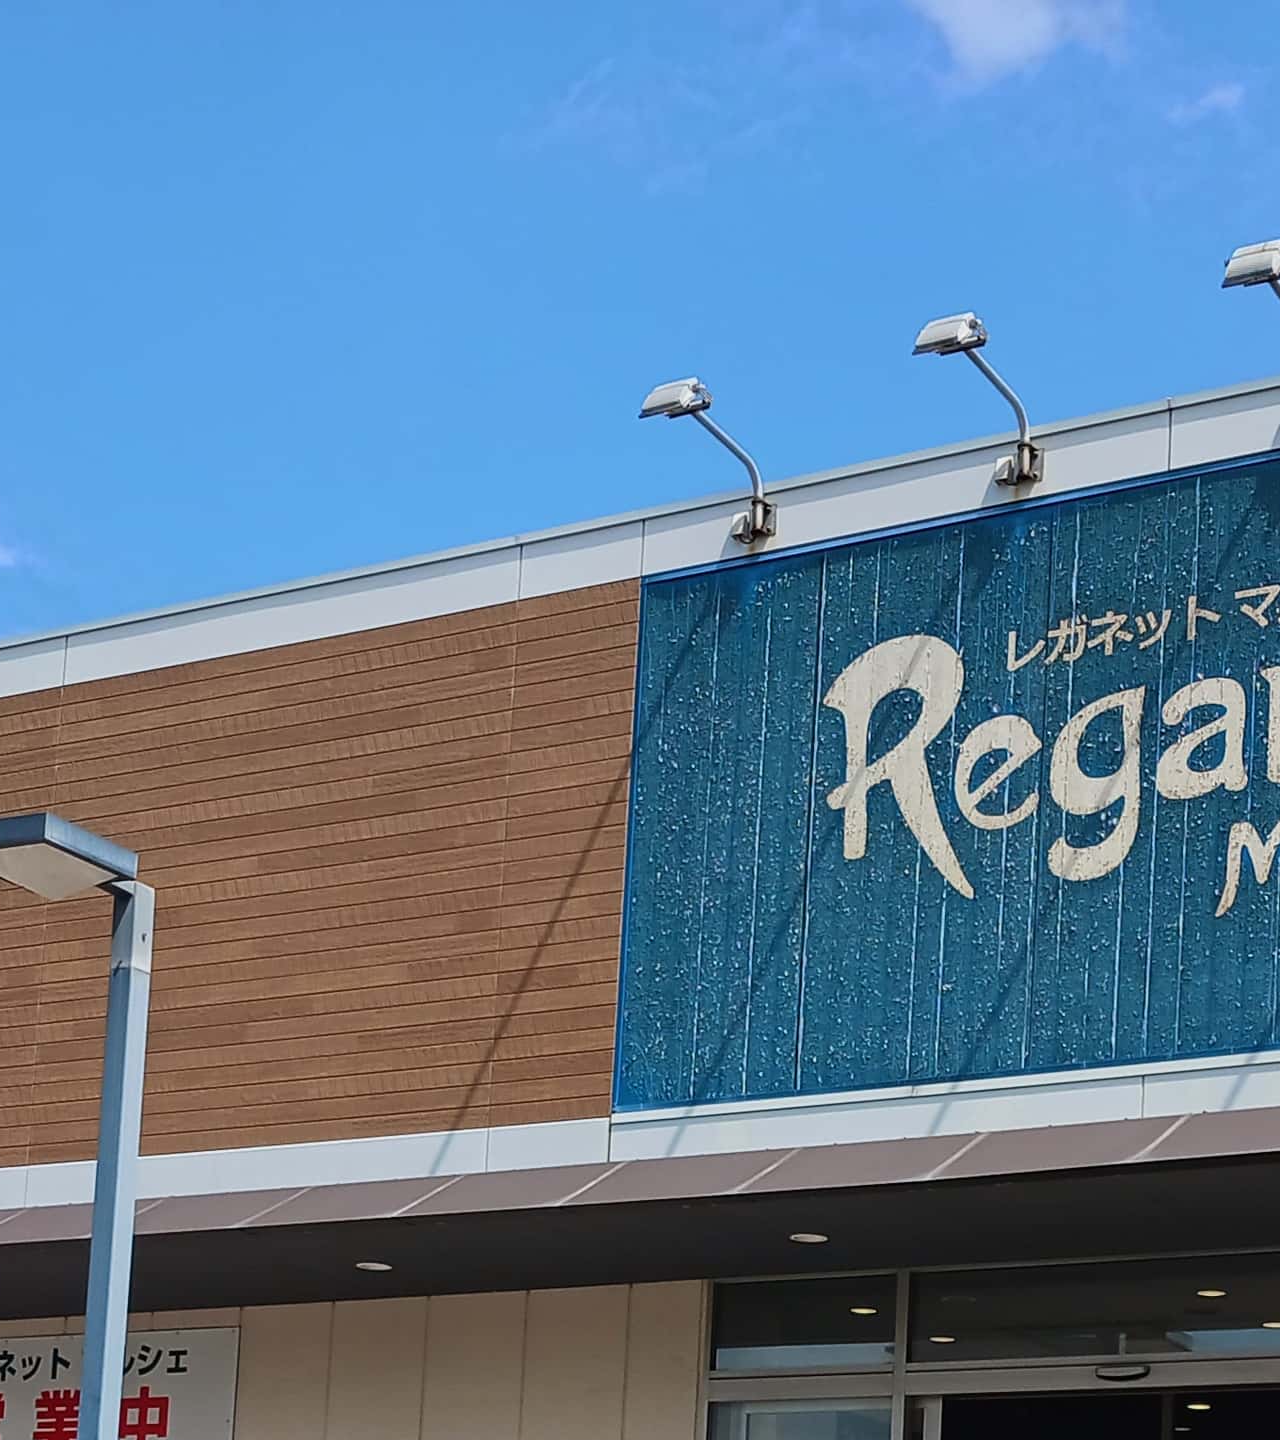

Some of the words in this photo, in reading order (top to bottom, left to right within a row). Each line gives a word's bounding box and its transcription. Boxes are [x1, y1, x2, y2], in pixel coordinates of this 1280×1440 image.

[1006, 596, 1220, 672] レガネット
